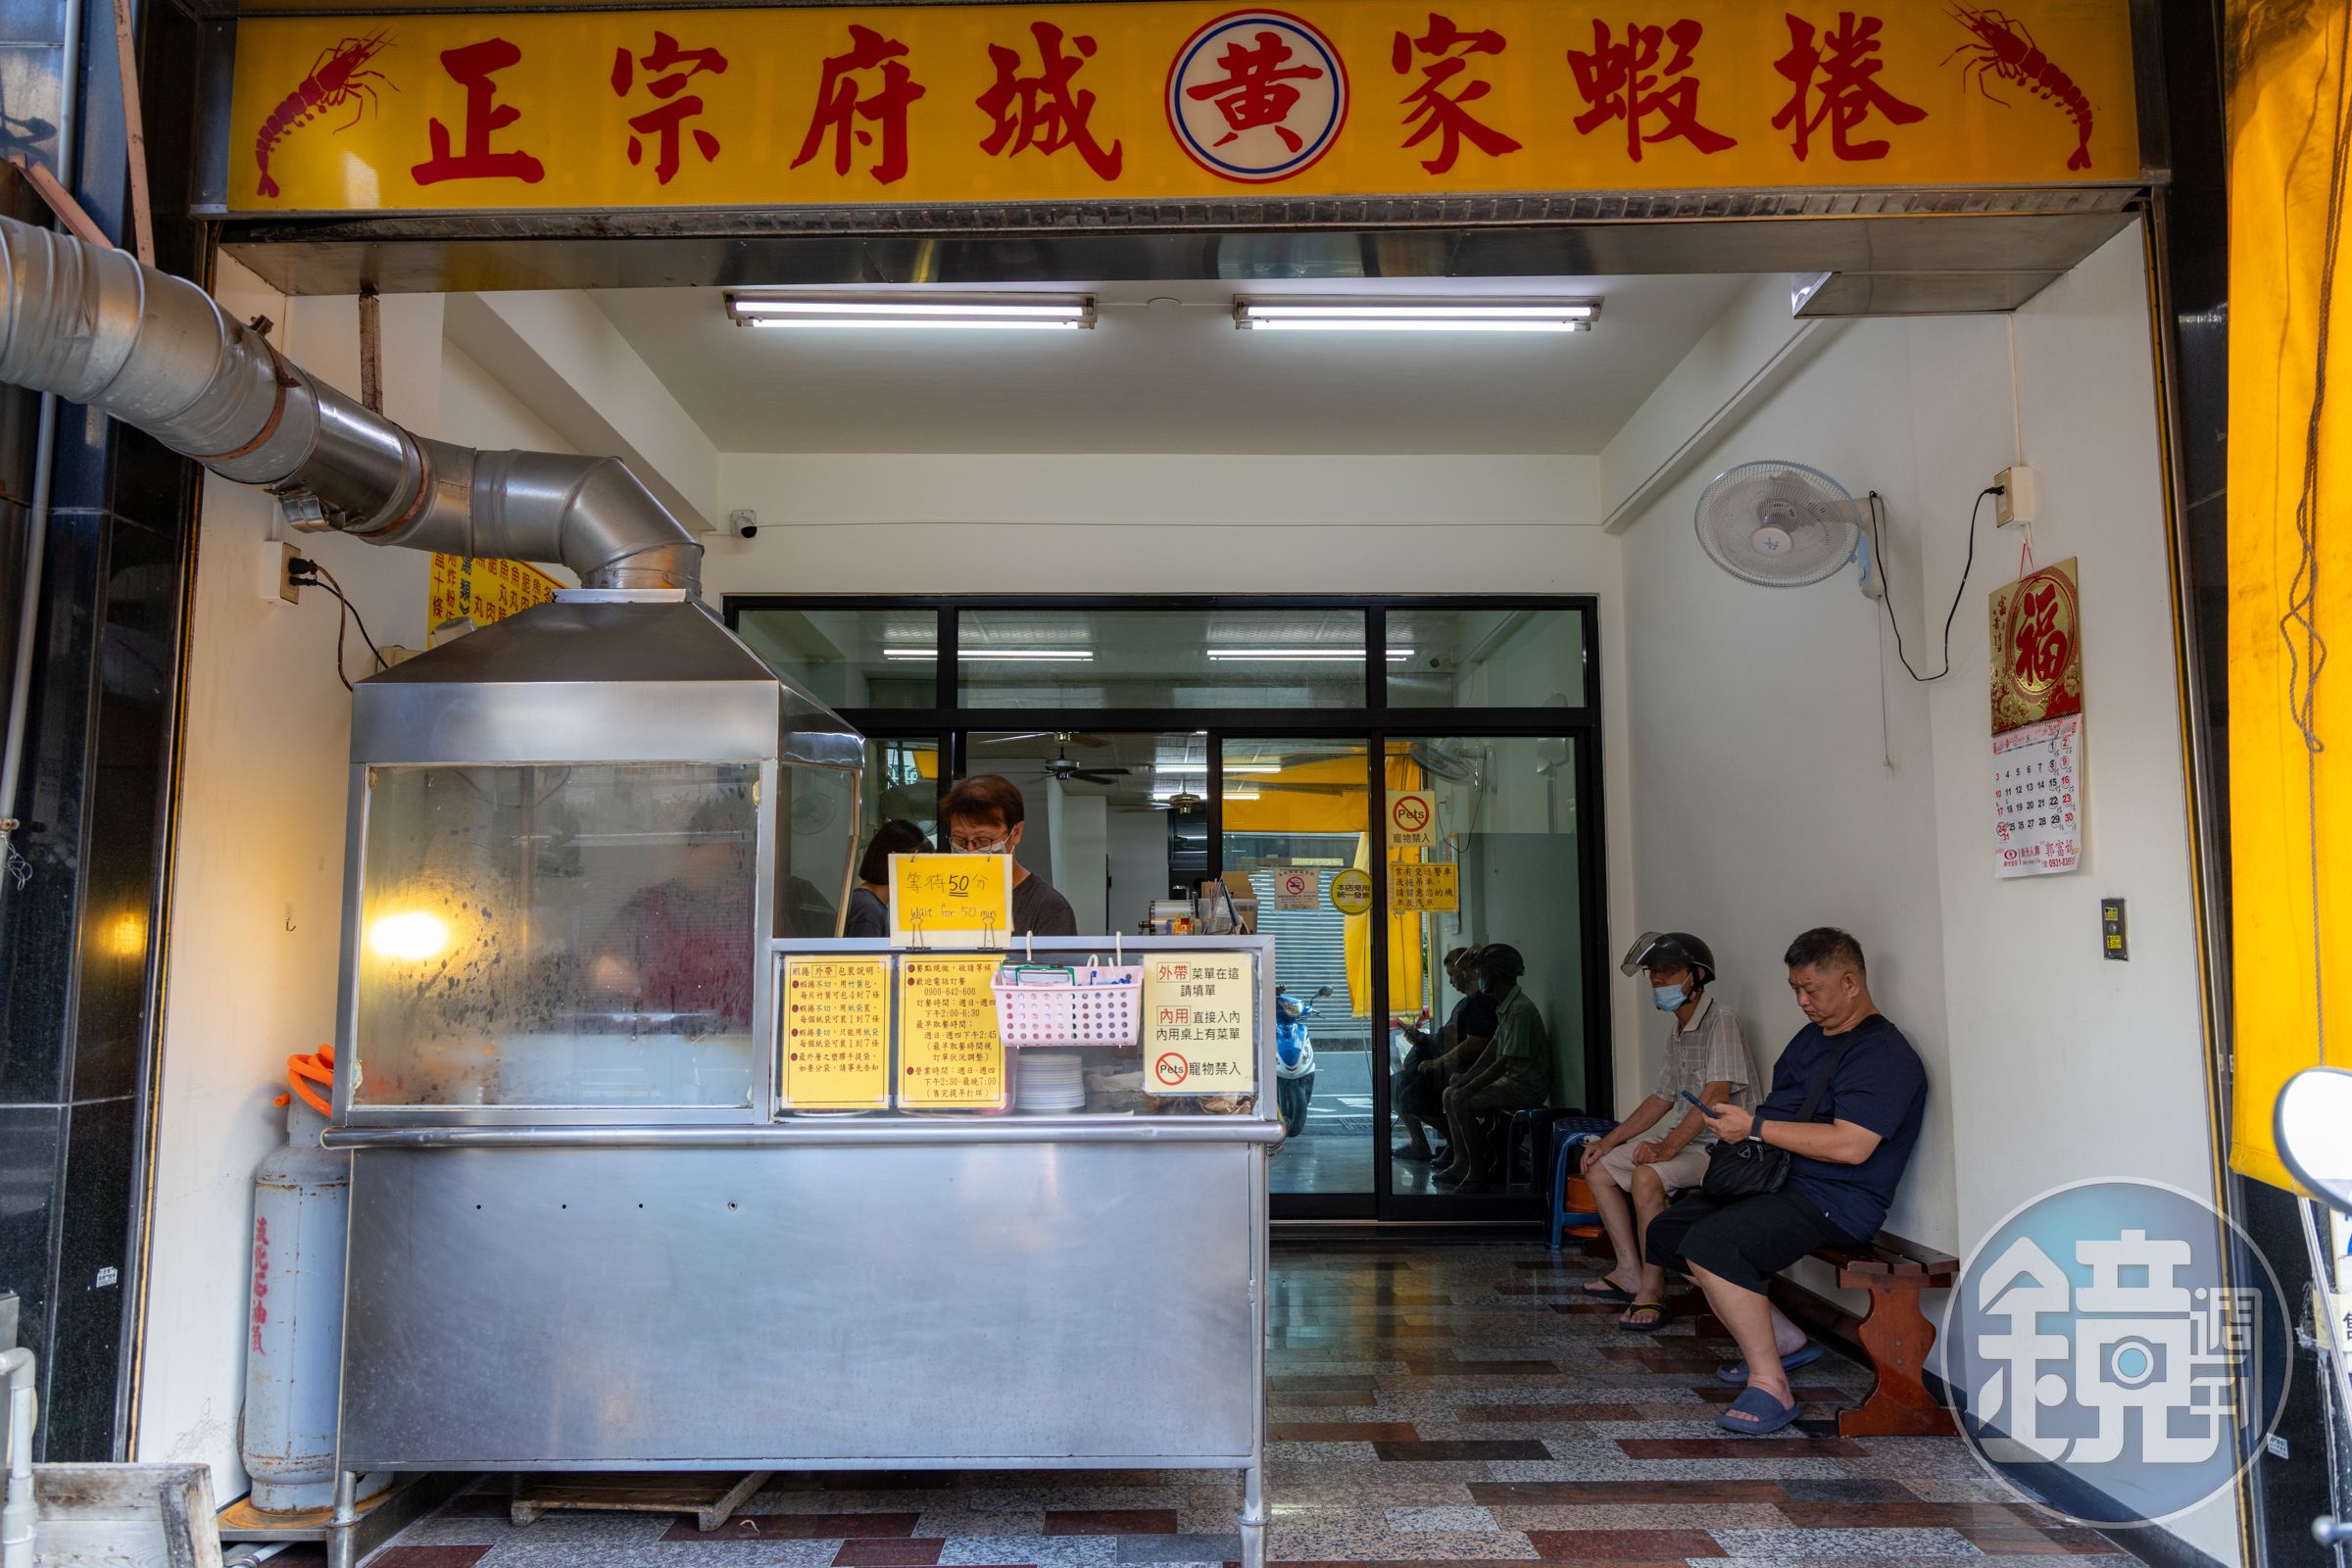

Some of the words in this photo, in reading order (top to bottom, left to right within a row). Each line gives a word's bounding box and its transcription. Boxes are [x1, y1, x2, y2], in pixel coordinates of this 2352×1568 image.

[2016, 583, 2068, 685] 福
[1398, 809, 1424, 819] Pets
[1393, 833, 1430, 843] 寵物禁入
[941, 903, 954, 917] for
[961, 906, 977, 917] 50
[980, 909, 996, 919] min
[1159, 965, 1188, 980] 外帶
[1192, 967, 1239, 980] 菜單在這
[925, 987, 976, 995] 0900-642-600
[1180, 984, 1216, 997] 請填單
[1160, 1008, 1188, 1024] 內用
[1160, 1065, 1184, 1074] Pets
[1188, 1062, 1241, 1076] 寵物禁入
